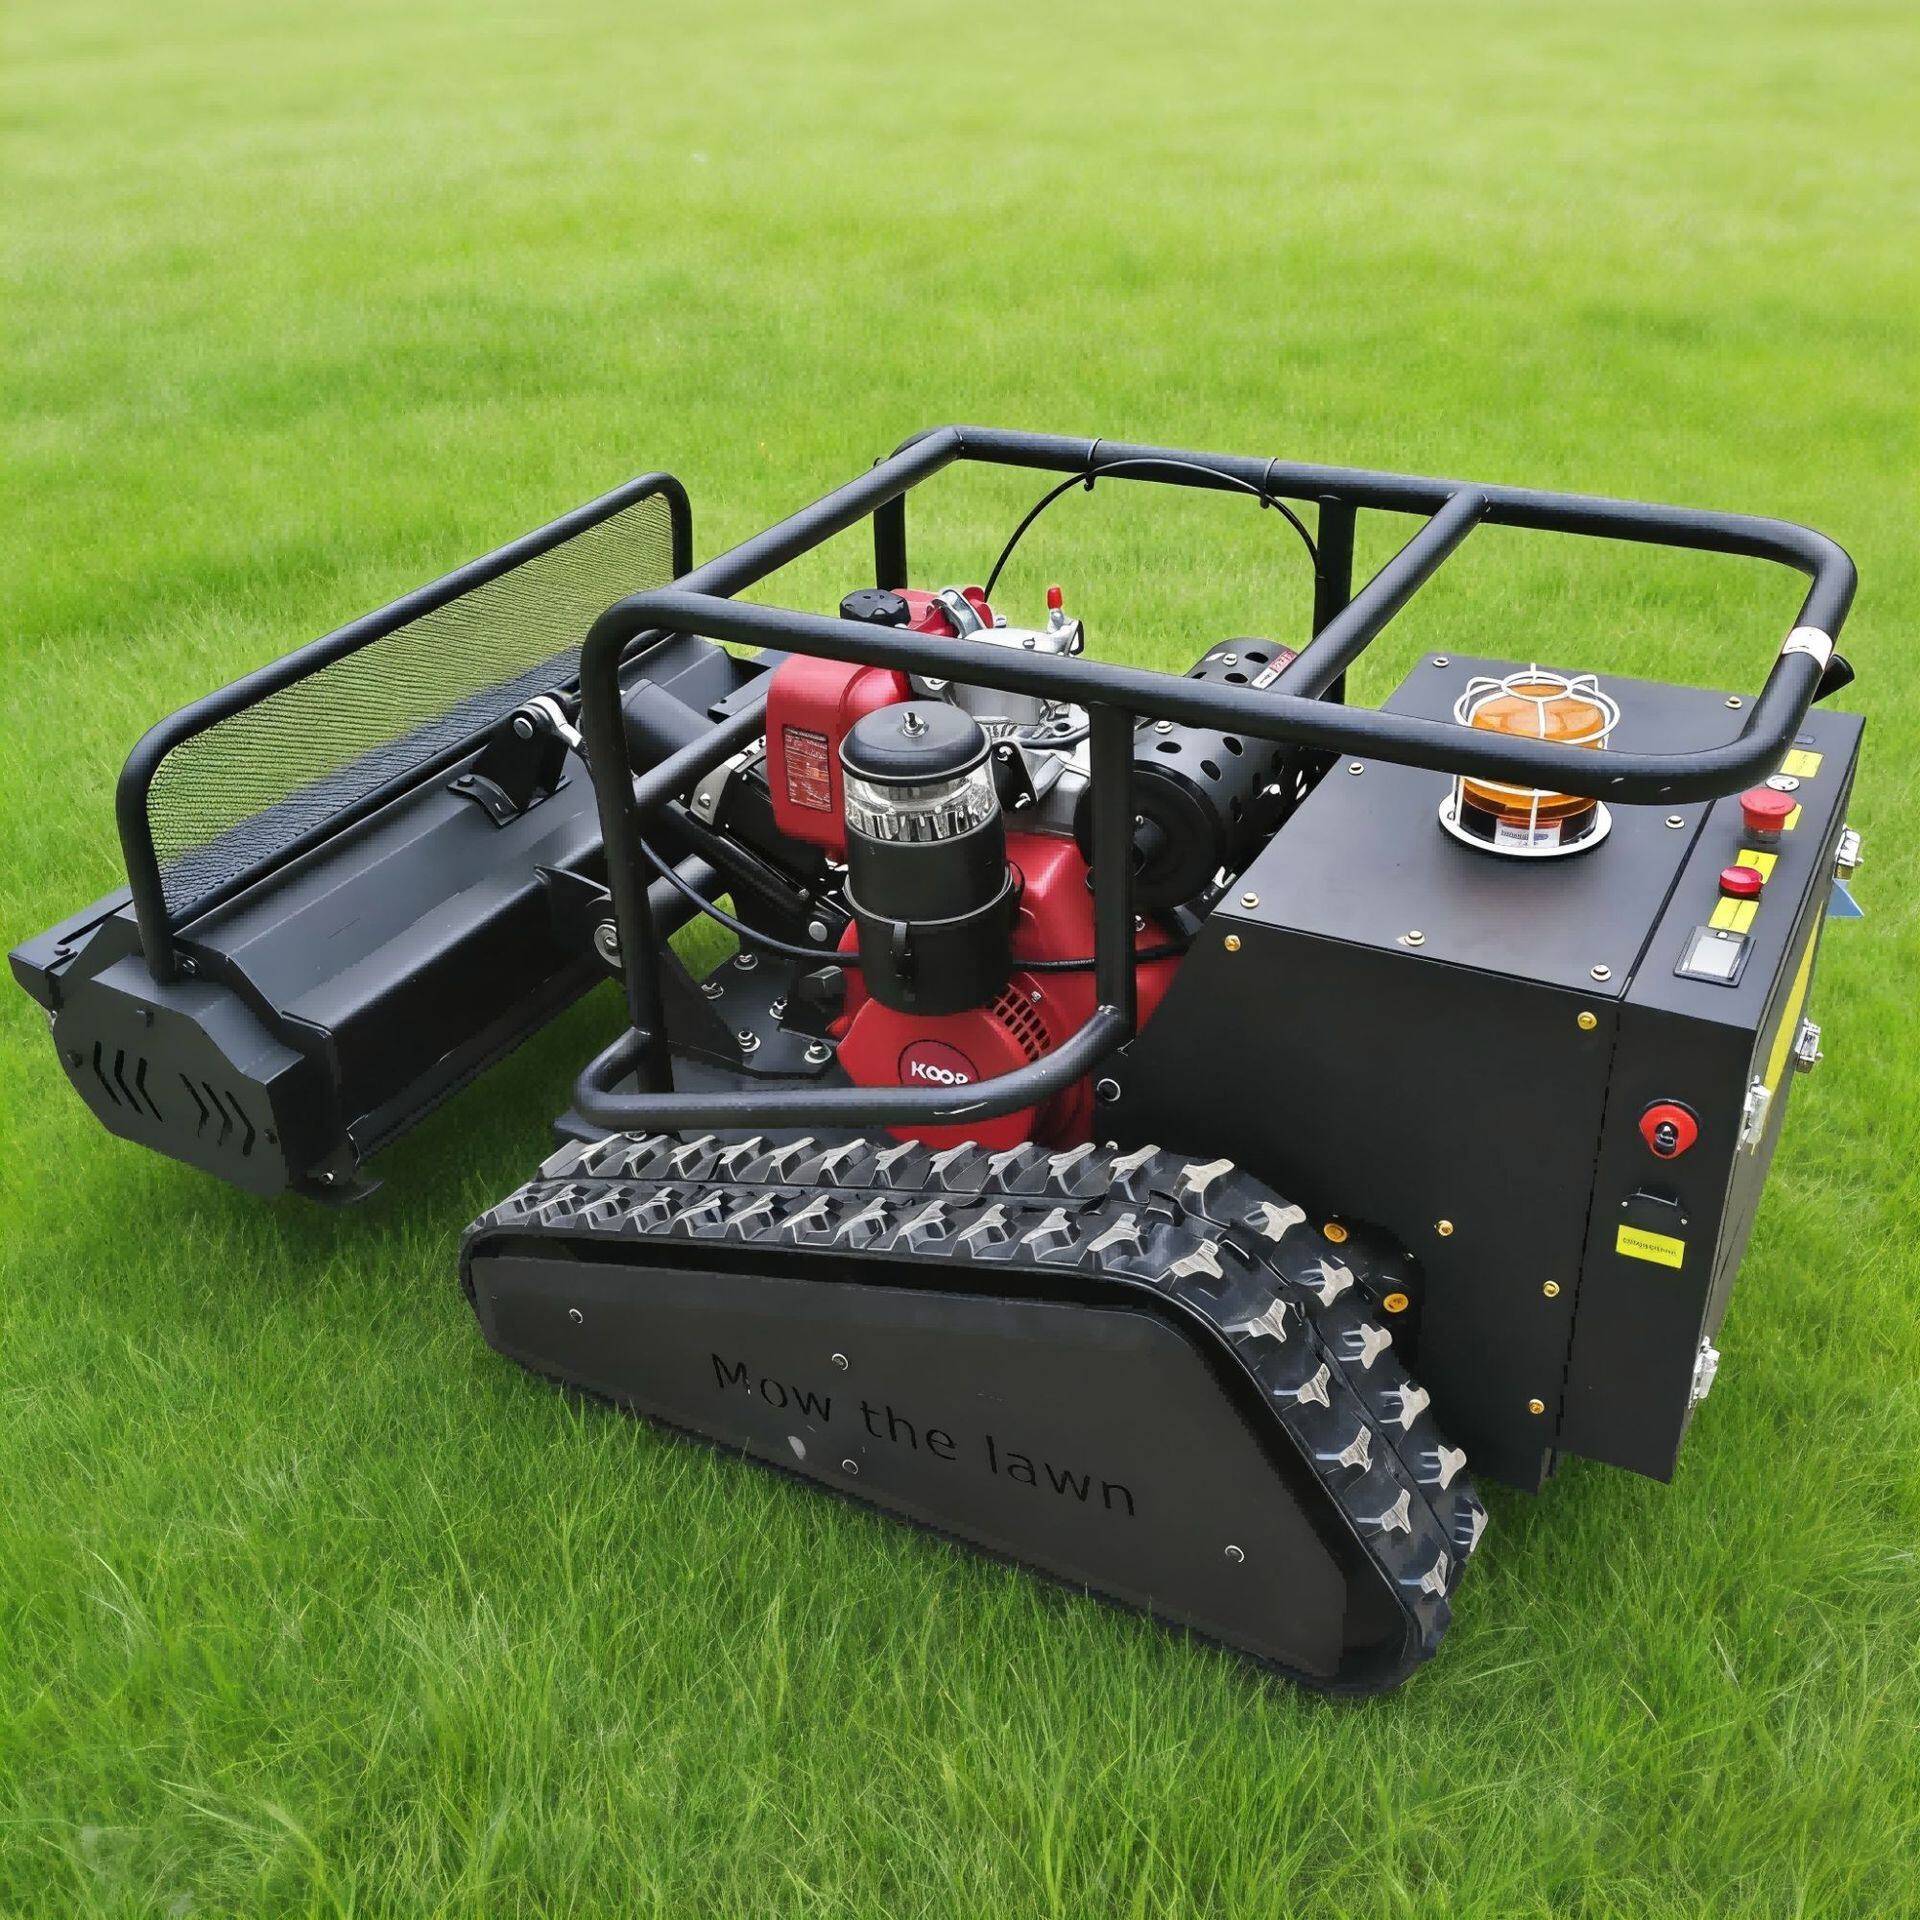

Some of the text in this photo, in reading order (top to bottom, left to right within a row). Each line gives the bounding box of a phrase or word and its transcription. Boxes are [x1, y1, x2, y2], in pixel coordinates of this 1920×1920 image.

[711, 1353, 1135, 1517] Mow the lawn
